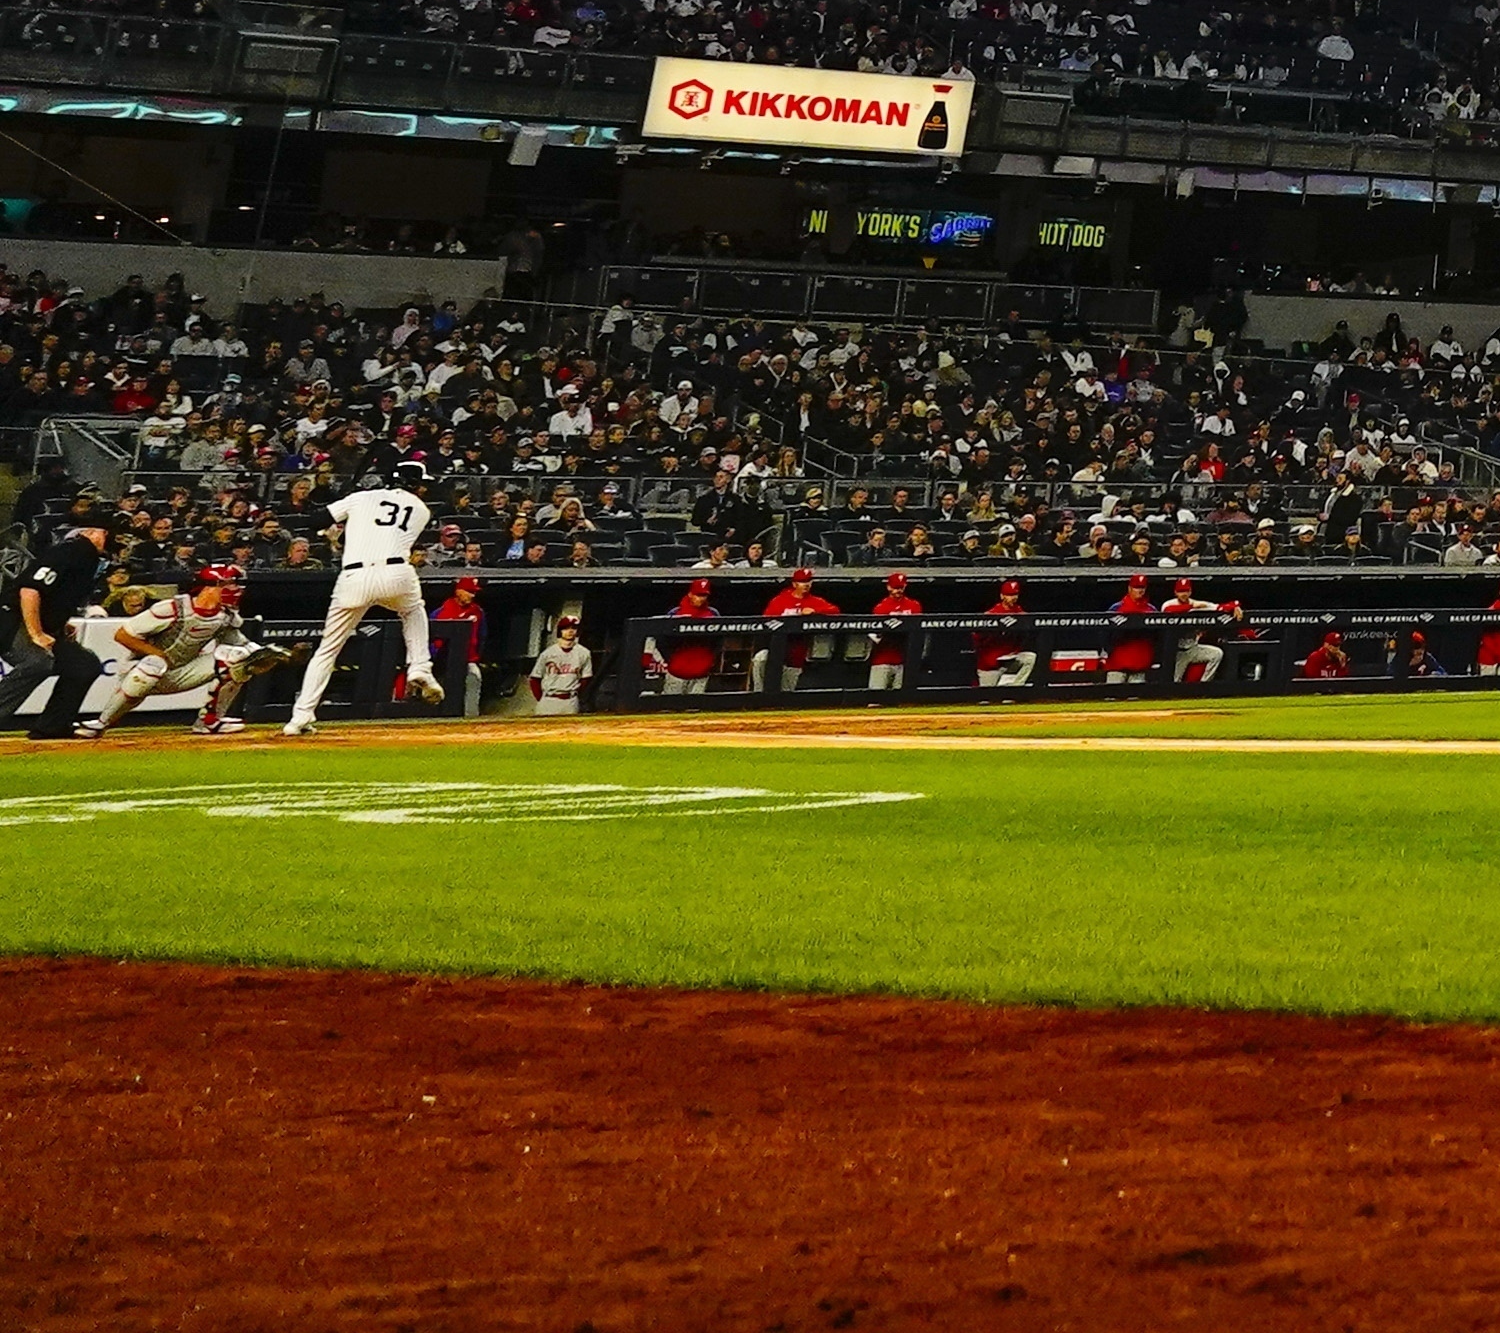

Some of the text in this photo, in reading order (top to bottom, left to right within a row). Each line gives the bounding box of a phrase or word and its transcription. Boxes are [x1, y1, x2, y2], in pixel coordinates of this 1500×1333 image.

[722, 89, 910, 127] KIKKOMAN
[857, 212, 921, 239] YORK'S
[1072, 224, 1105, 247] DOG
[374, 500, 414, 532] 31
[803, 621, 883, 630] BANK OF AMERICA
[921, 619, 998, 628] BANK OF AMERICA
[1035, 618, 1109, 626] BANK OF AMERICA
[1144, 617, 1168, 625] BANK
[1168, 617, 1180, 625] OF
[679, 624, 706, 632] BANK
[721, 623, 764, 632] AMERICA
[262, 628, 292, 638] BANK
[293, 628, 309, 638] OF
